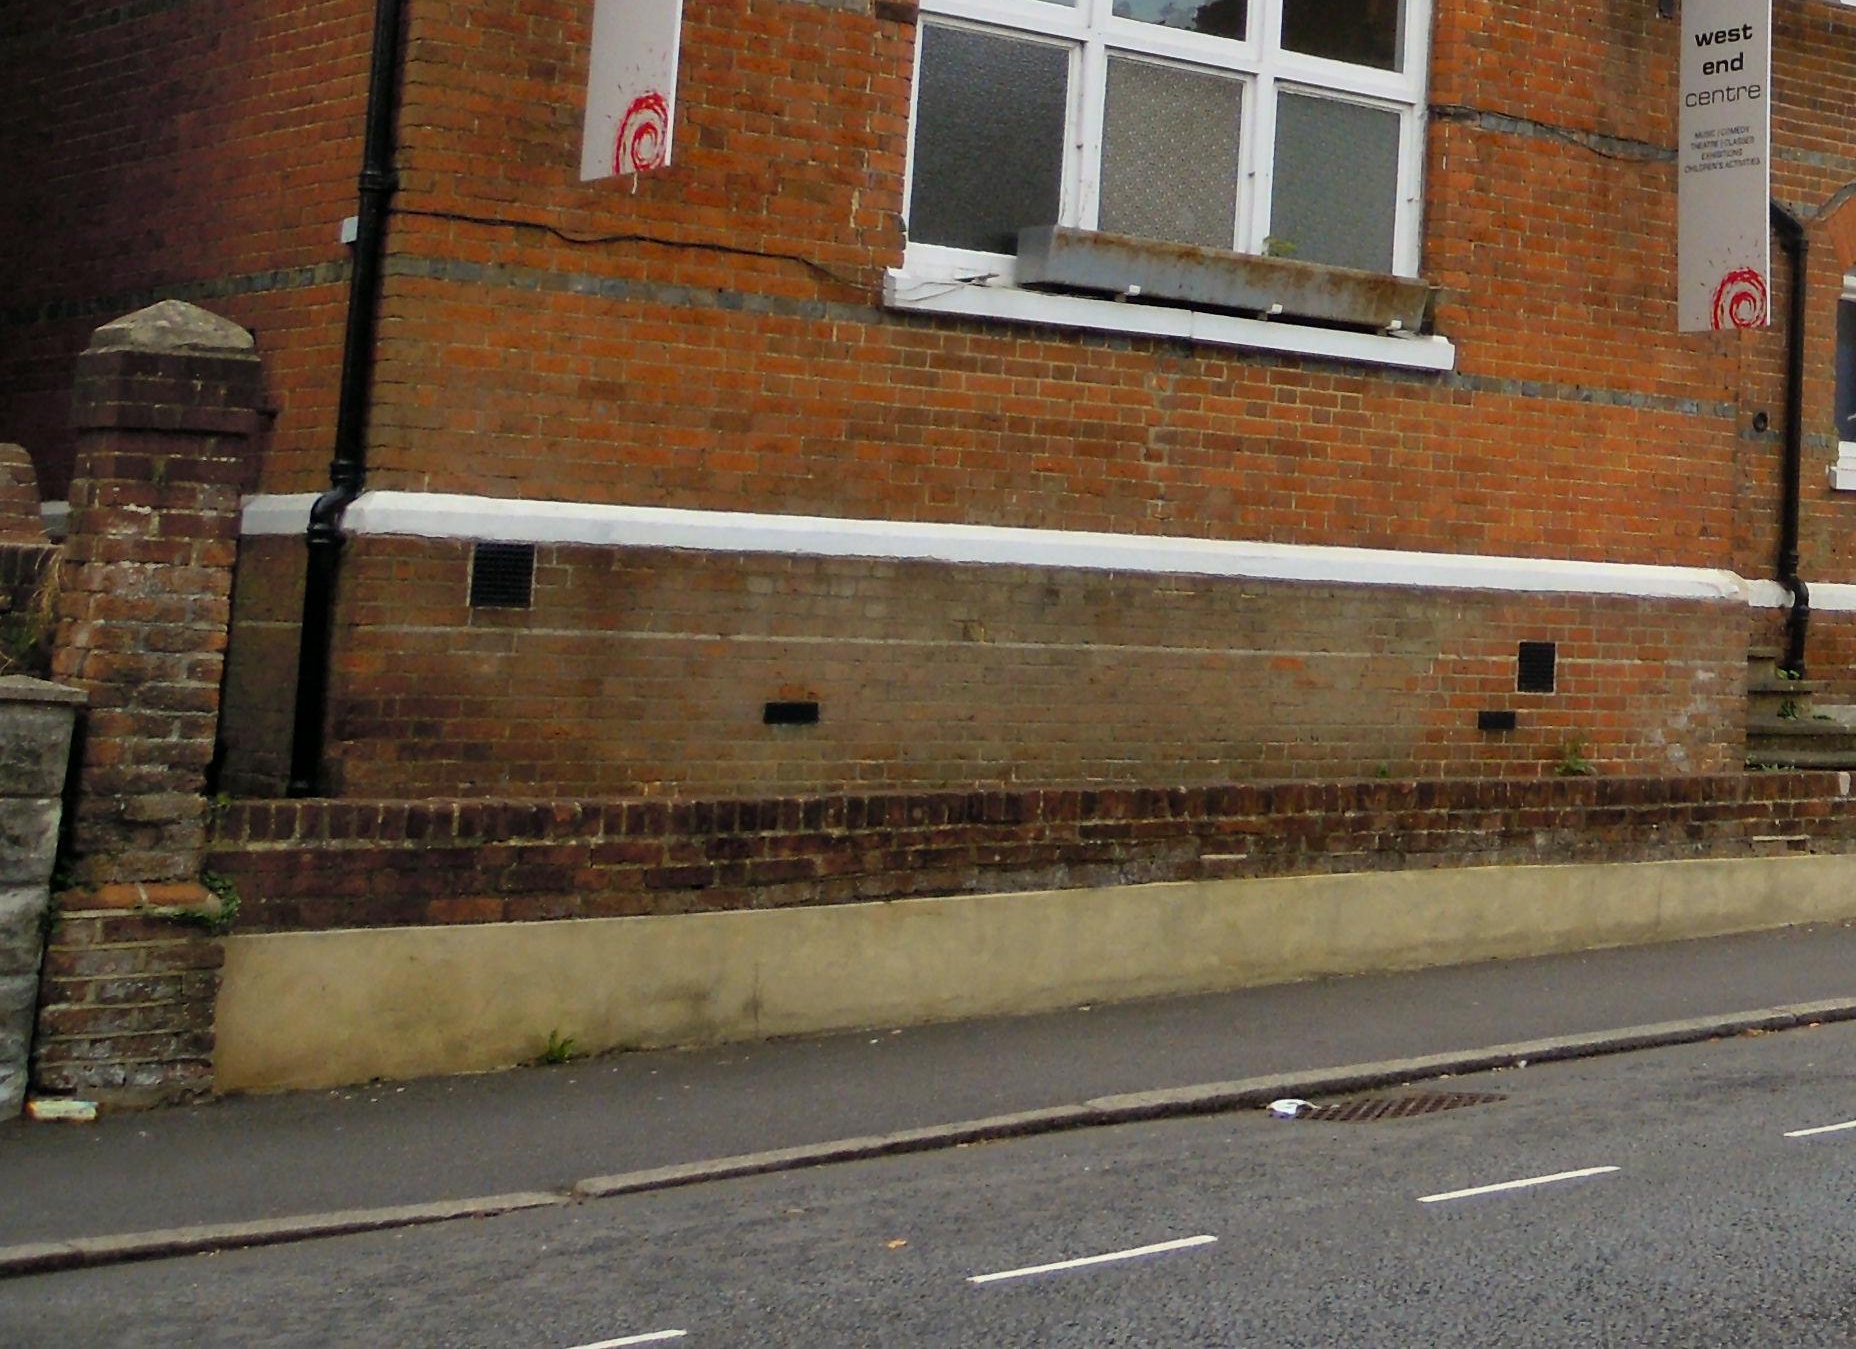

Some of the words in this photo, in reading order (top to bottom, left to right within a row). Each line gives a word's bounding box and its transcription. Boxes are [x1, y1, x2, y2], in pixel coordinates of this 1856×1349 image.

[1694, 23, 1753, 47] west
[1702, 52, 1744, 76] end
[1685, 84, 1761, 108] centre
